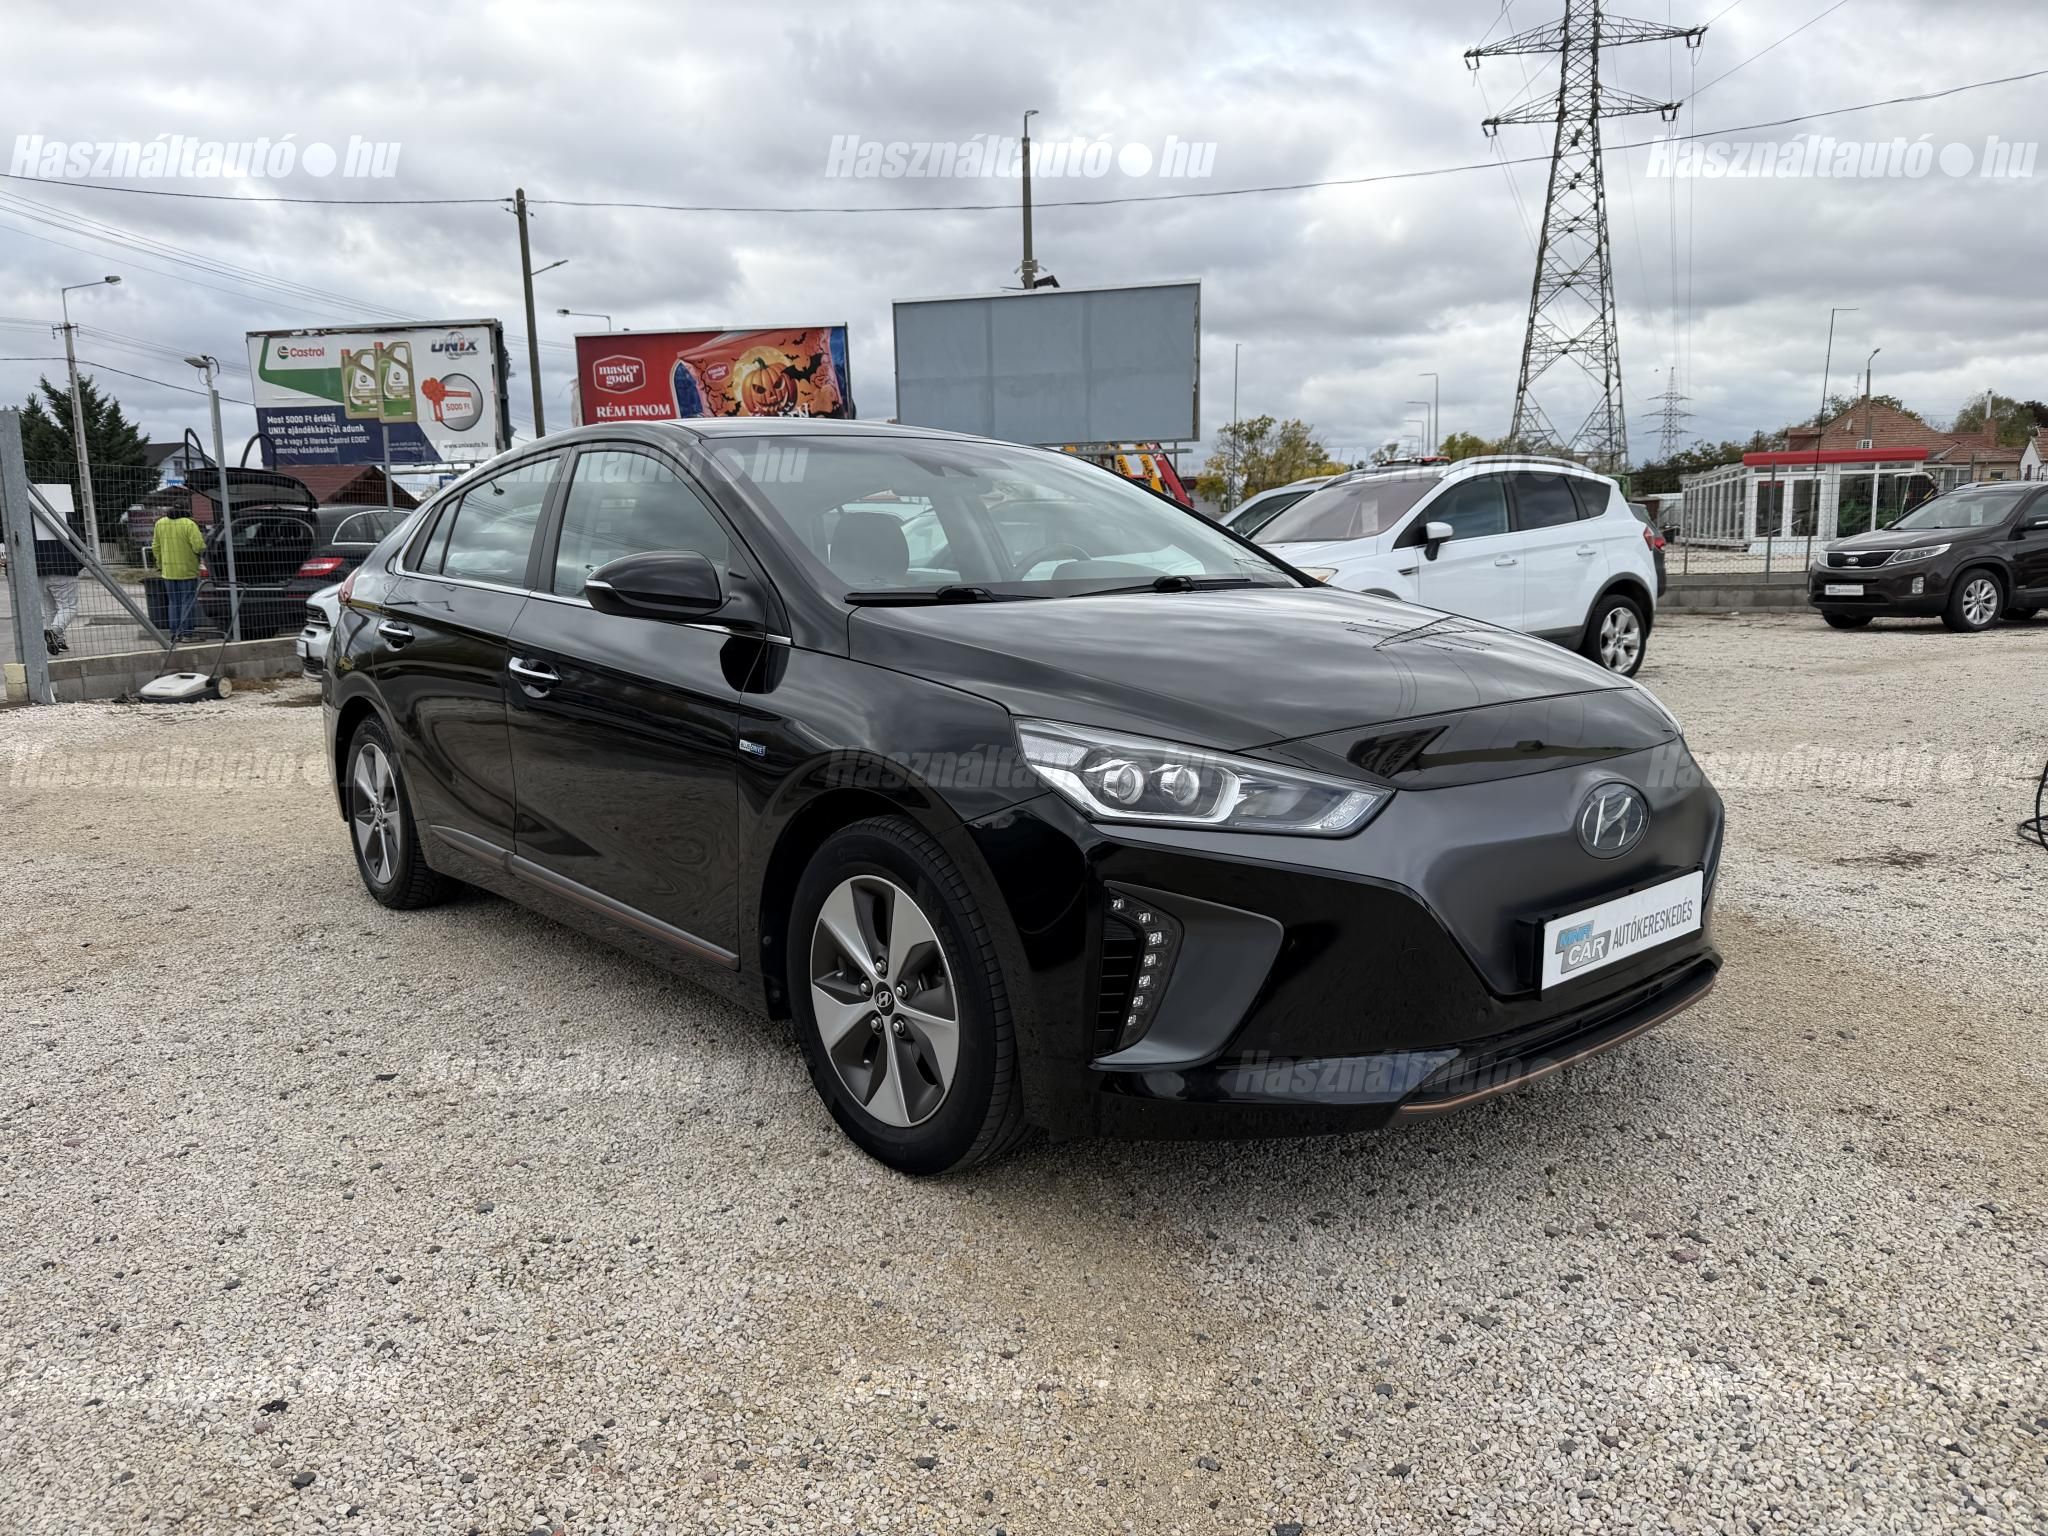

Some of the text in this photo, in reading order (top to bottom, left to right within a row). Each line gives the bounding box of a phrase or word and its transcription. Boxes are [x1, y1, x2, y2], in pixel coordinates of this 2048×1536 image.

[431, 337, 480, 352] UNIX
[290, 346, 325, 358] Castrol
[599, 363, 640, 375] master
[606, 371, 634, 386] good
[446, 402, 471, 411] 5000 Ft
[596, 402, 671, 417] RÉM FINOM
[267, 416, 284, 424] Most
[285, 415, 304, 424] 5000
[304, 415, 312, 423] Ft
[342, 424, 365, 432] adunk
[1568, 897, 1694, 966] CAR AUTÓKERESKEDÉS
